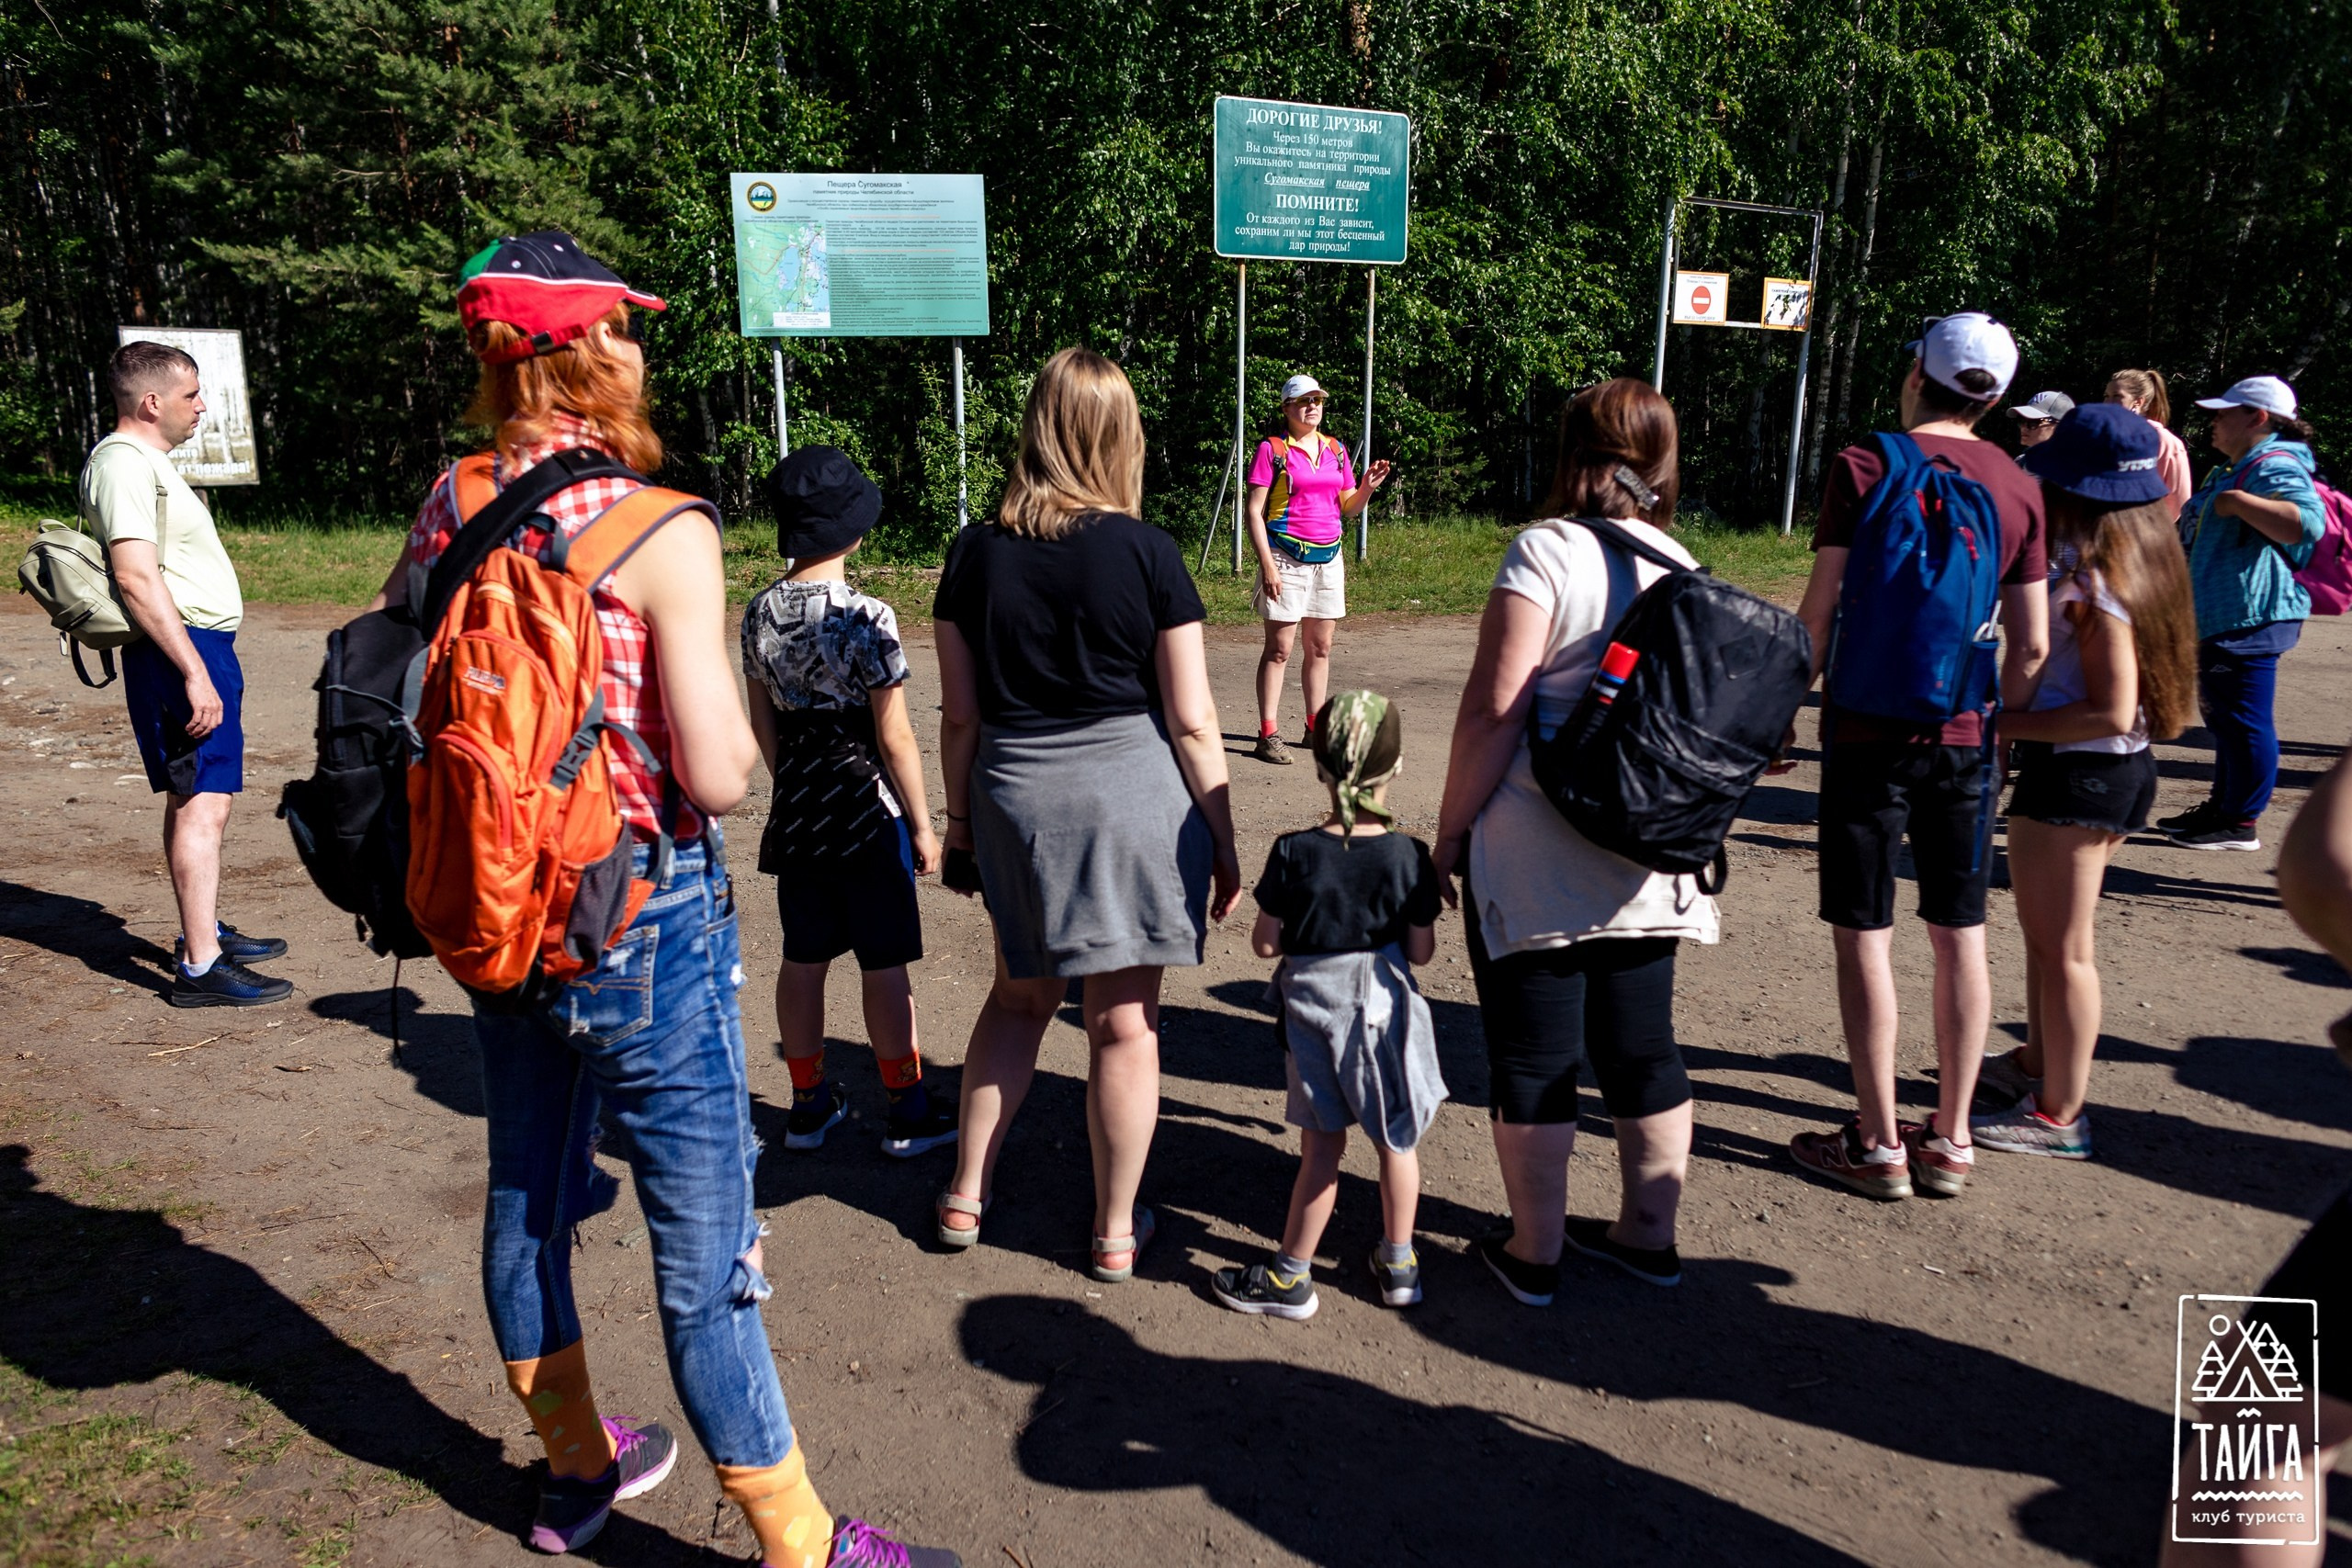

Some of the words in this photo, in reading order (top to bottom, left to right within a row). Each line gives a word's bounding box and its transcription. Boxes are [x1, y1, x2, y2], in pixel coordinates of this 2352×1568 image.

[1247, 108, 1320, 129] ДОРОГИЕ
[1324, 117, 1382, 134] ДРУЗЬЯ!
[1273, 131, 1300, 144] Через
[1304, 133, 1318, 145] 150
[1321, 137, 1352, 148] метров
[1246, 141, 1261, 152] Вы
[1263, 146, 1311, 157] окажитесь
[1316, 150, 1326, 158] на
[1329, 151, 1379, 163] территории
[1235, 155, 1293, 168] уникального
[1298, 161, 1346, 172] памятника
[1354, 164, 1391, 175] природы
[827, 180, 856, 189] Пещера
[858, 180, 902, 189] Сугомакская
[1264, 173, 1325, 187] Сугомакская
[1336, 179, 1370, 191] пещера
[1276, 195, 1359, 212] ПОМНИТЕ!
[1247, 213, 1259, 223] От
[1262, 215, 1300, 226] каждого
[1305, 218, 1314, 226] из
[1318, 216, 1335, 226] Вас
[1340, 220, 1374, 230] зависит,
[1235, 226, 1279, 238] сохраним
[1283, 229, 1295, 237] ли
[1298, 230, 1311, 238] мы
[1316, 231, 1334, 239] этот
[1338, 228, 1385, 241] бесценный
[1289, 242, 1305, 253] дар
[1309, 242, 1350, 253] природы!
[195, 460, 250, 475] пожара!
